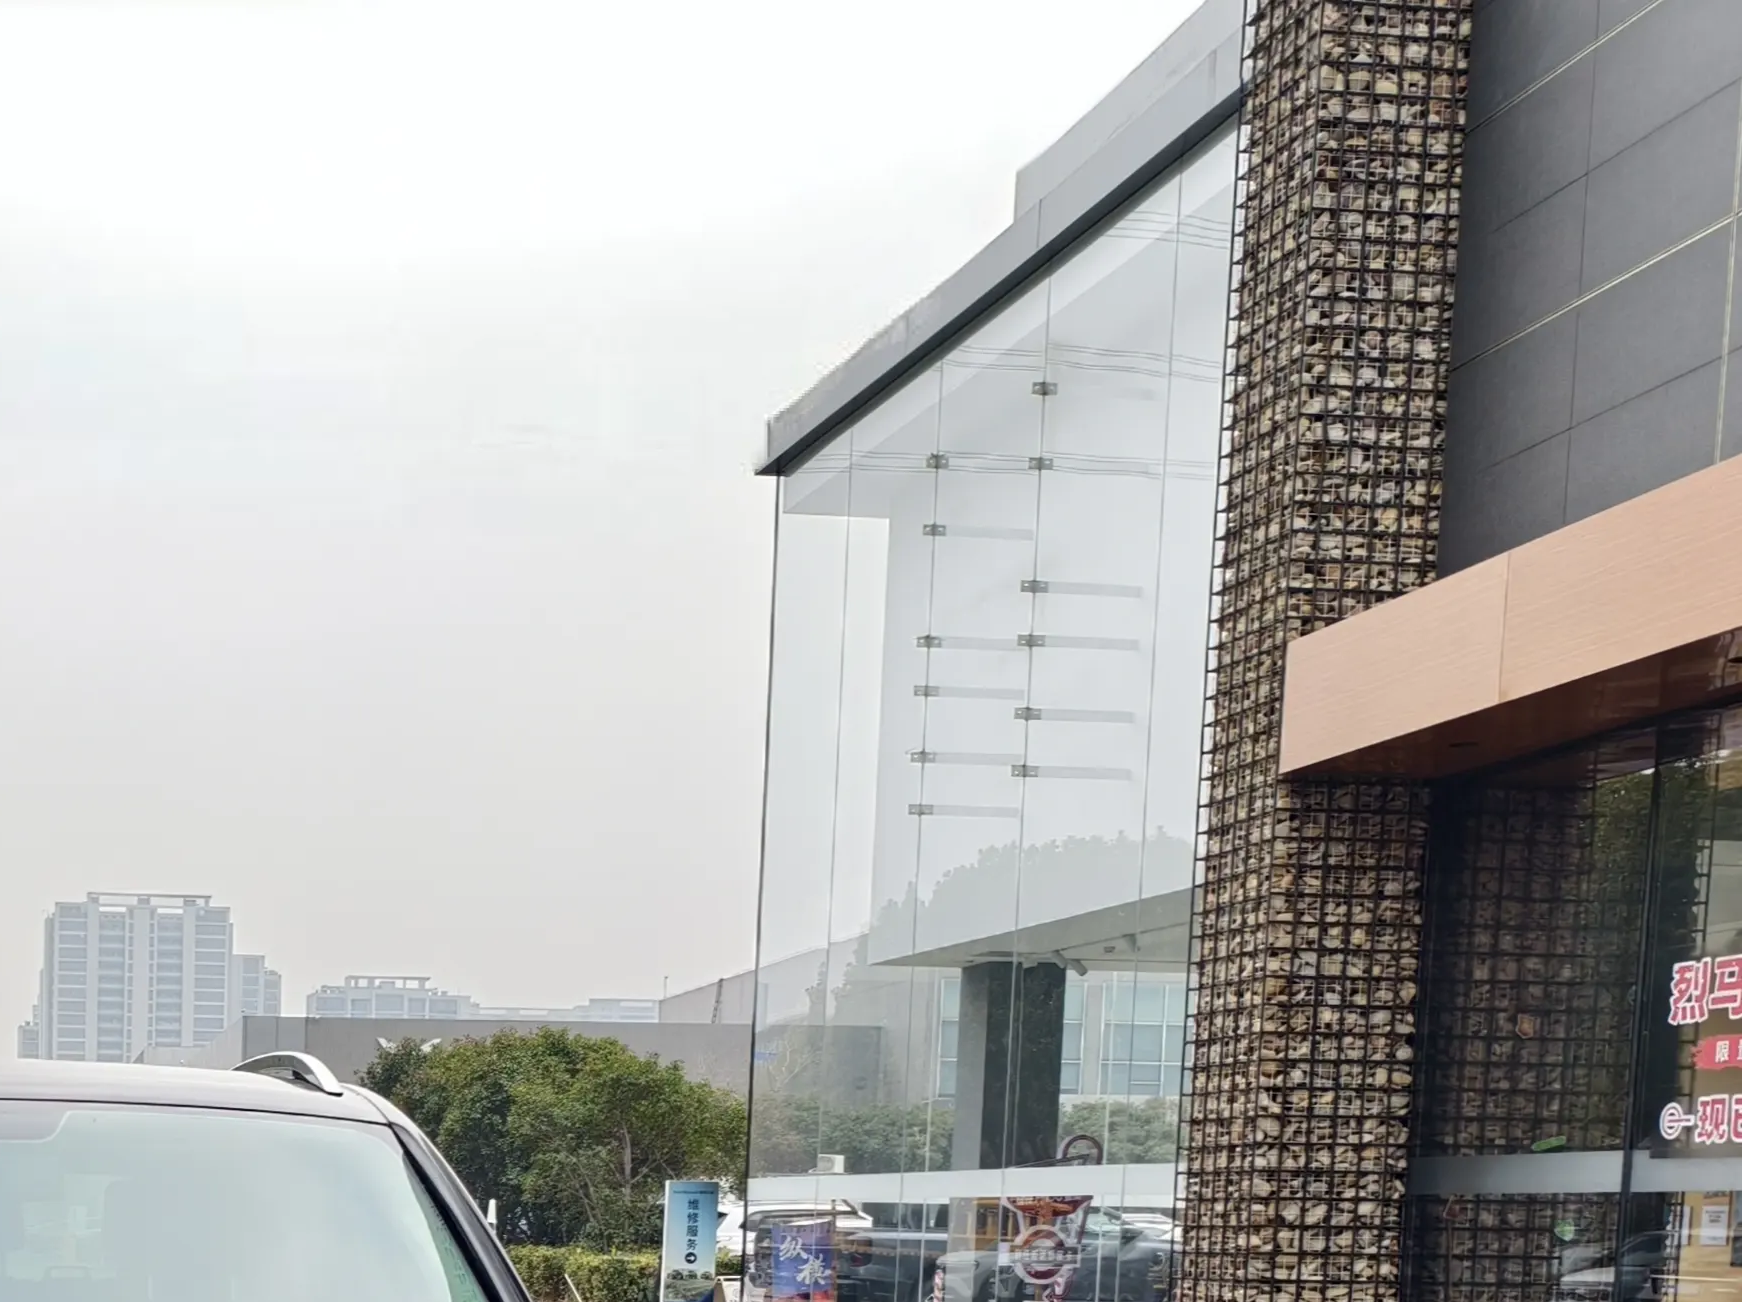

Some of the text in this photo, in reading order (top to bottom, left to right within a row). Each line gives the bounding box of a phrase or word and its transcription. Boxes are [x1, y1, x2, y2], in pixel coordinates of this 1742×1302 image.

[1668, 957, 1742, 1026] 烈马
[686, 1198, 700, 1251] 维修服务
[779, 1235, 832, 1285] 纵横
